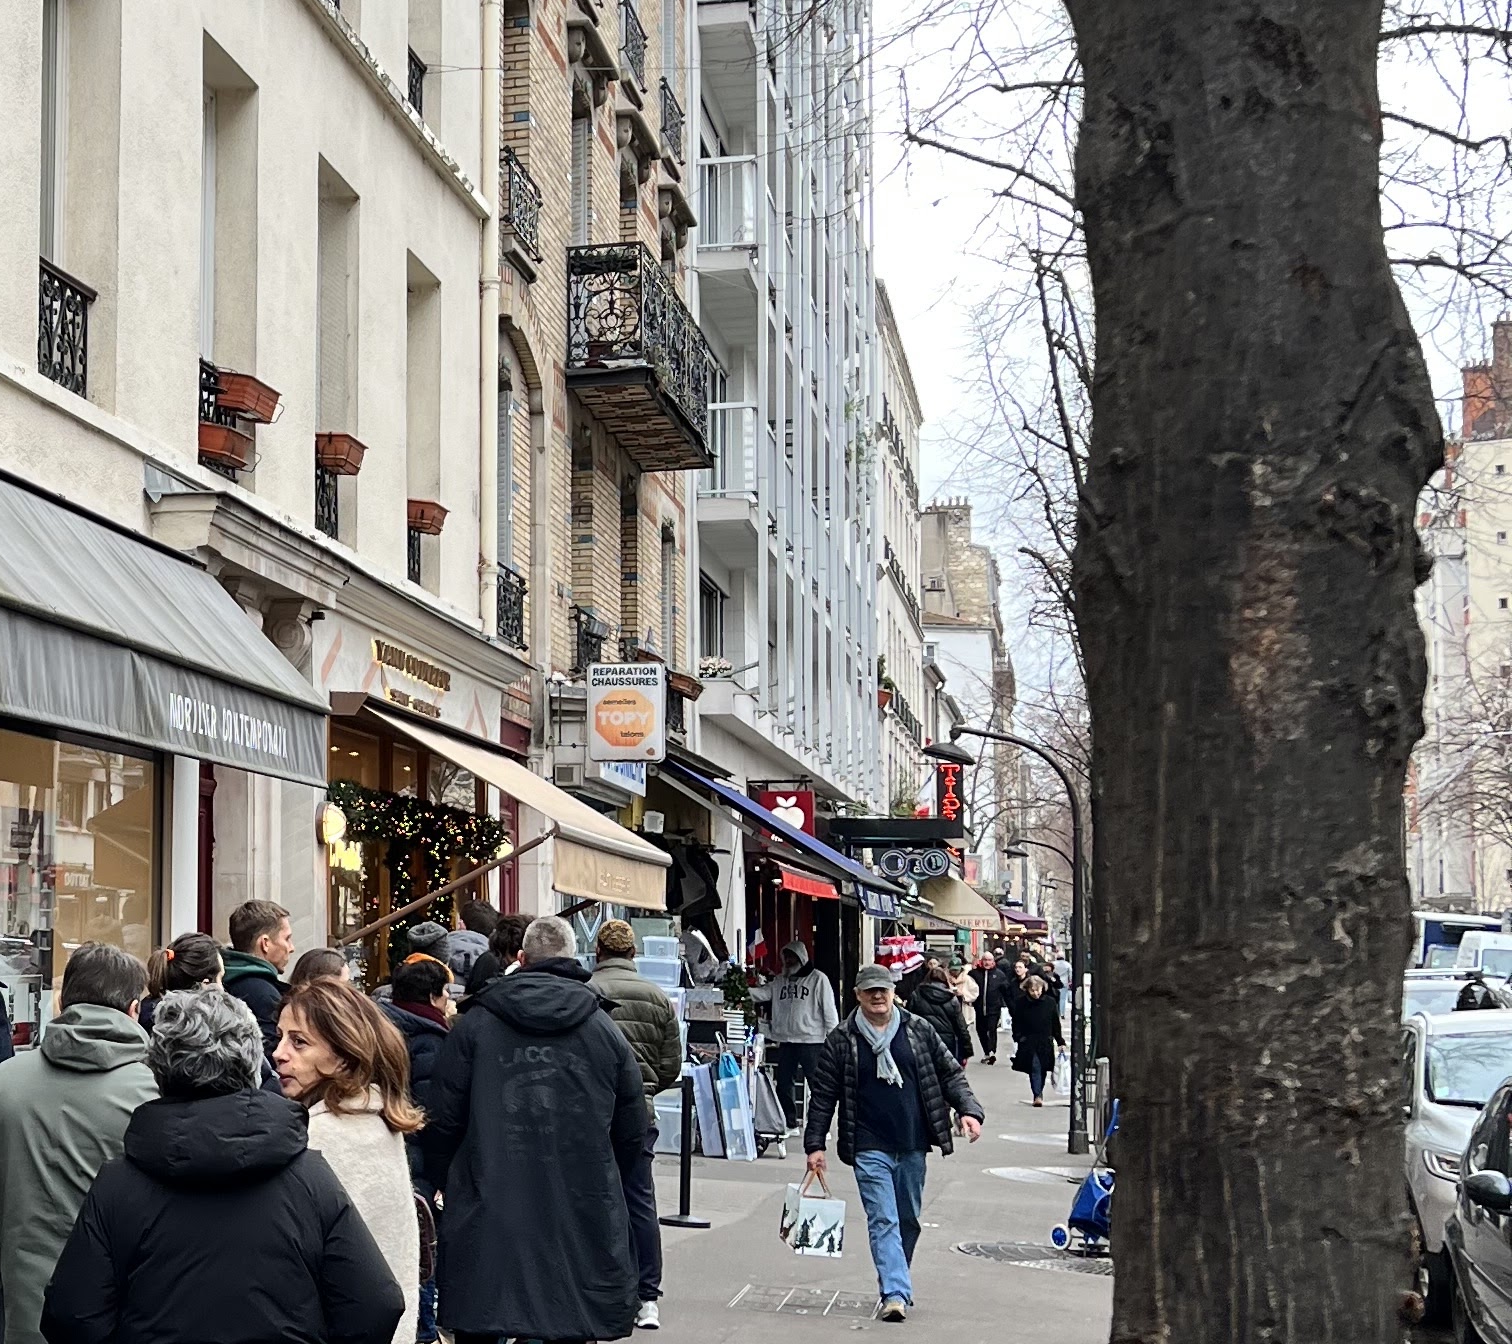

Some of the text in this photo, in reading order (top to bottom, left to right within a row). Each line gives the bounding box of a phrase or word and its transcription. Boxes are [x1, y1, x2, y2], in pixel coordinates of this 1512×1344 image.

[592, 667, 657, 677] REPARATION
[591, 677, 659, 687] CHAUSSURES
[597, 710, 649, 726] TOPY
